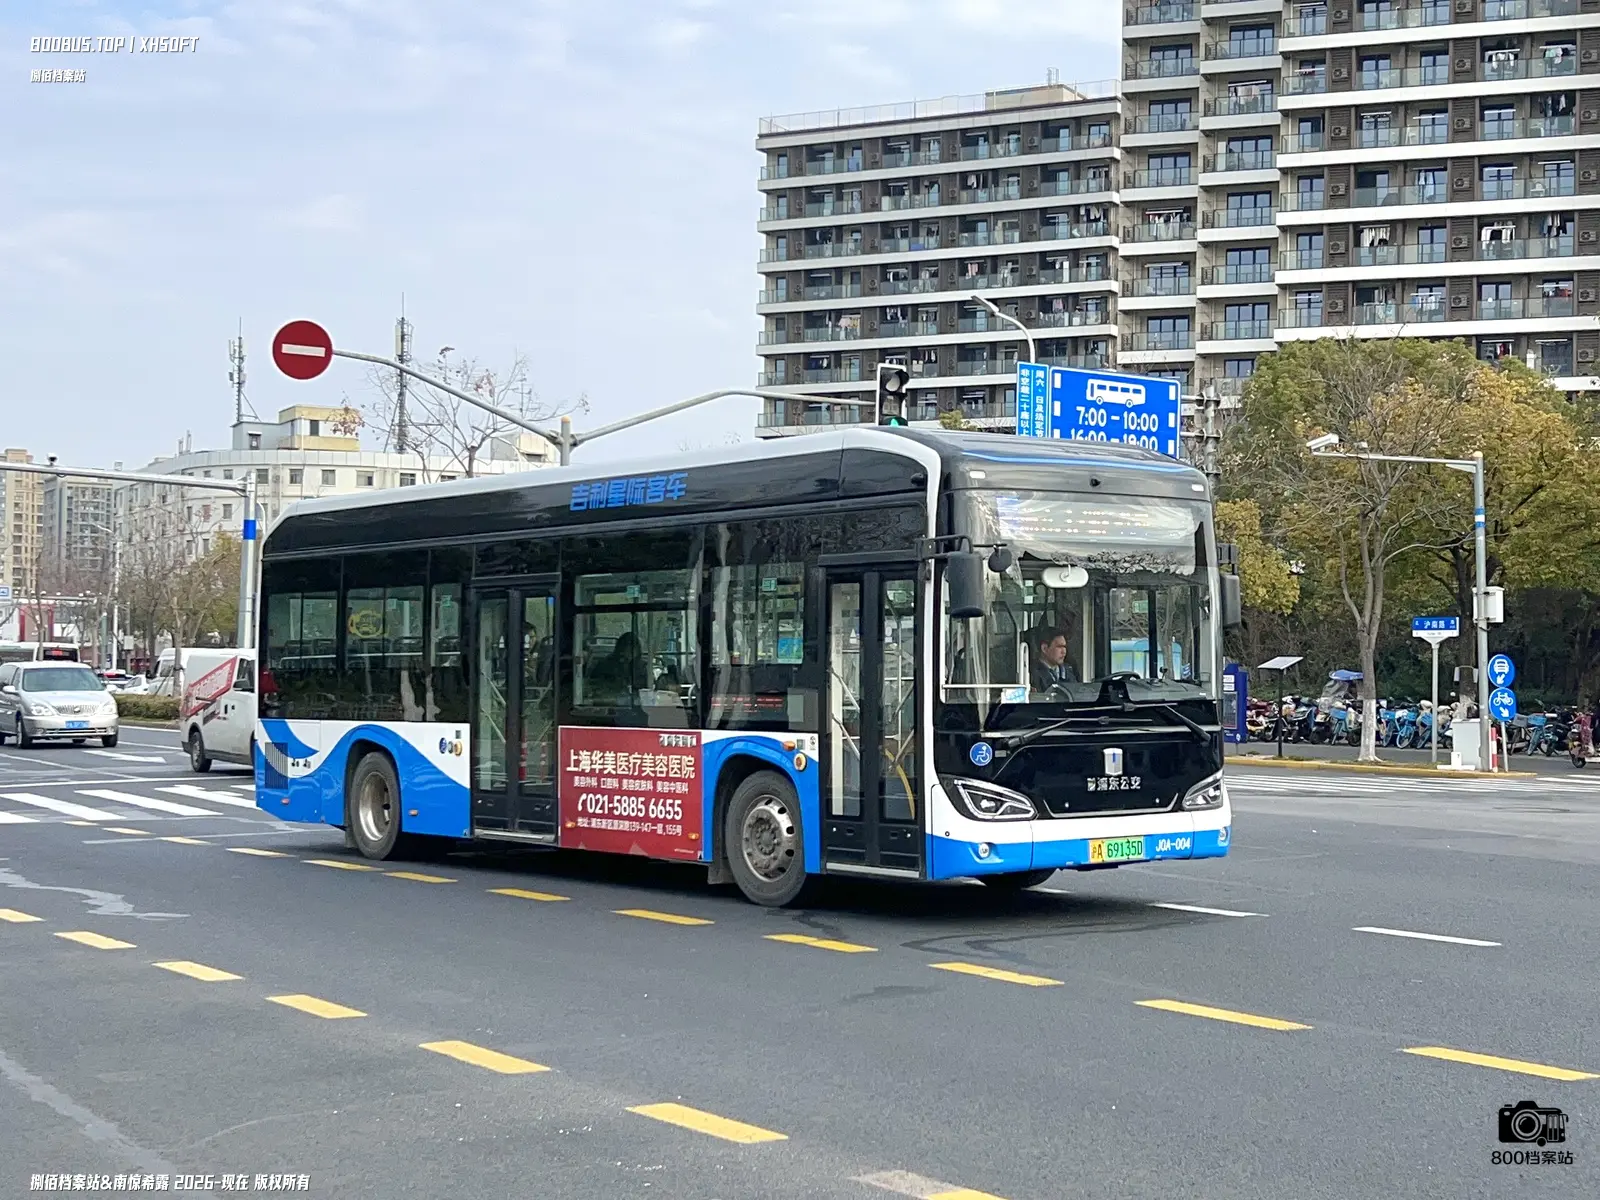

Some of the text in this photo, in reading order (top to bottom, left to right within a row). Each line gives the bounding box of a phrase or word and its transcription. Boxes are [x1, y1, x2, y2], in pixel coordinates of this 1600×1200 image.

[1076, 406, 1107, 427] 7:00
[1123, 410, 1159, 432] 10:00
[570, 472, 688, 511] 吉利星际客车
[566, 749, 696, 779] 上海华美医疗美容医院
[1097, 776, 1141, 791] 浦东公交
[587, 793, 682, 820] 021-5885 6655
[1107, 840, 1143, 858] 69135D
